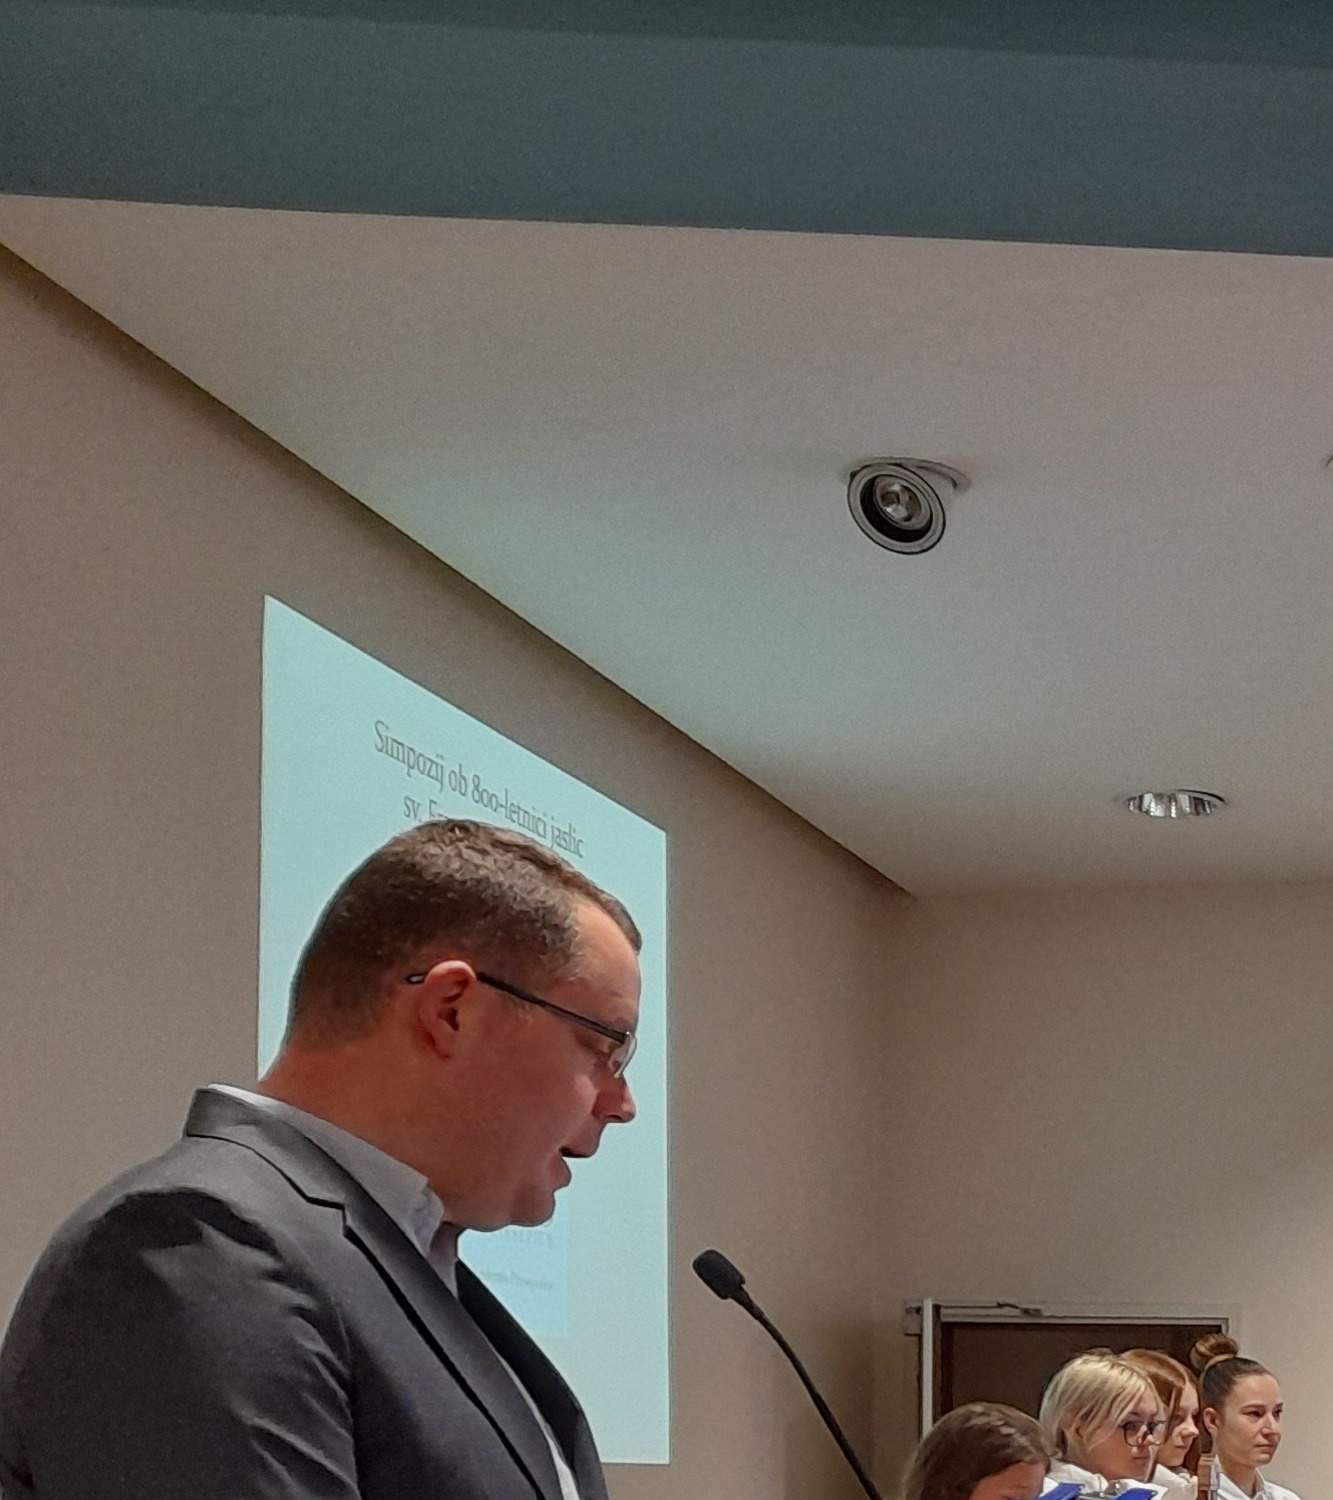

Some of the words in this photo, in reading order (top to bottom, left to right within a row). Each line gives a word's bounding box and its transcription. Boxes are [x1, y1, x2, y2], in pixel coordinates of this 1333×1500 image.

[374, 720, 444, 792] Simpozij
[448, 763, 468, 797] ob
[472, 774, 547, 837] 800-letnici
[550, 815, 584, 858] jaslic
[403, 795, 422, 822] sv.
